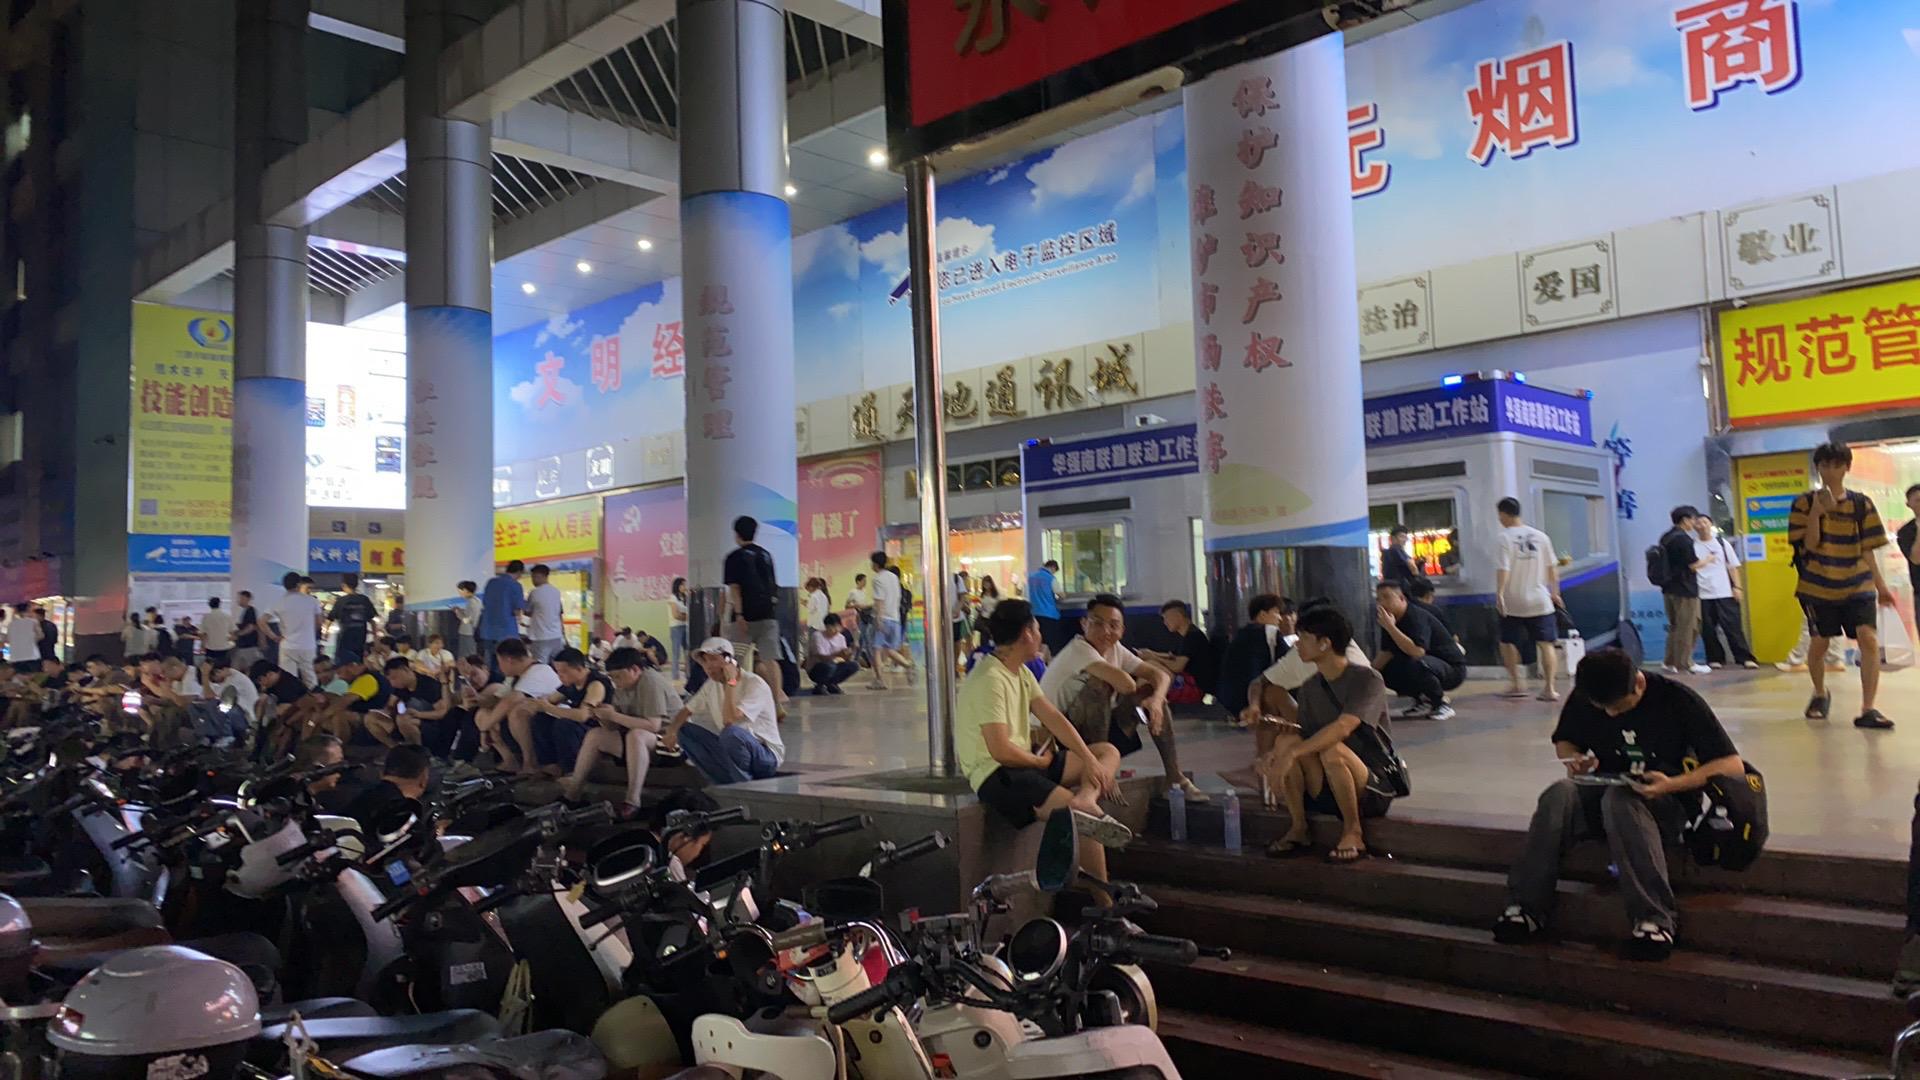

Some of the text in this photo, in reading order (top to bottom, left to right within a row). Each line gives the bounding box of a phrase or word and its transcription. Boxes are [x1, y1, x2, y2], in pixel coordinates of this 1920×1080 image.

[1231, 75, 1293, 373] 保护知识产权
[1737, 222, 1823, 265] 敬业
[938, 221, 1116, 291] 您已进入电子监控区域
[1534, 264, 1601, 304] 爱国
[1361, 299, 1419, 336] 法治
[142, 378, 234, 419] 技能创造
[538, 511, 592, 542] 人人有责
